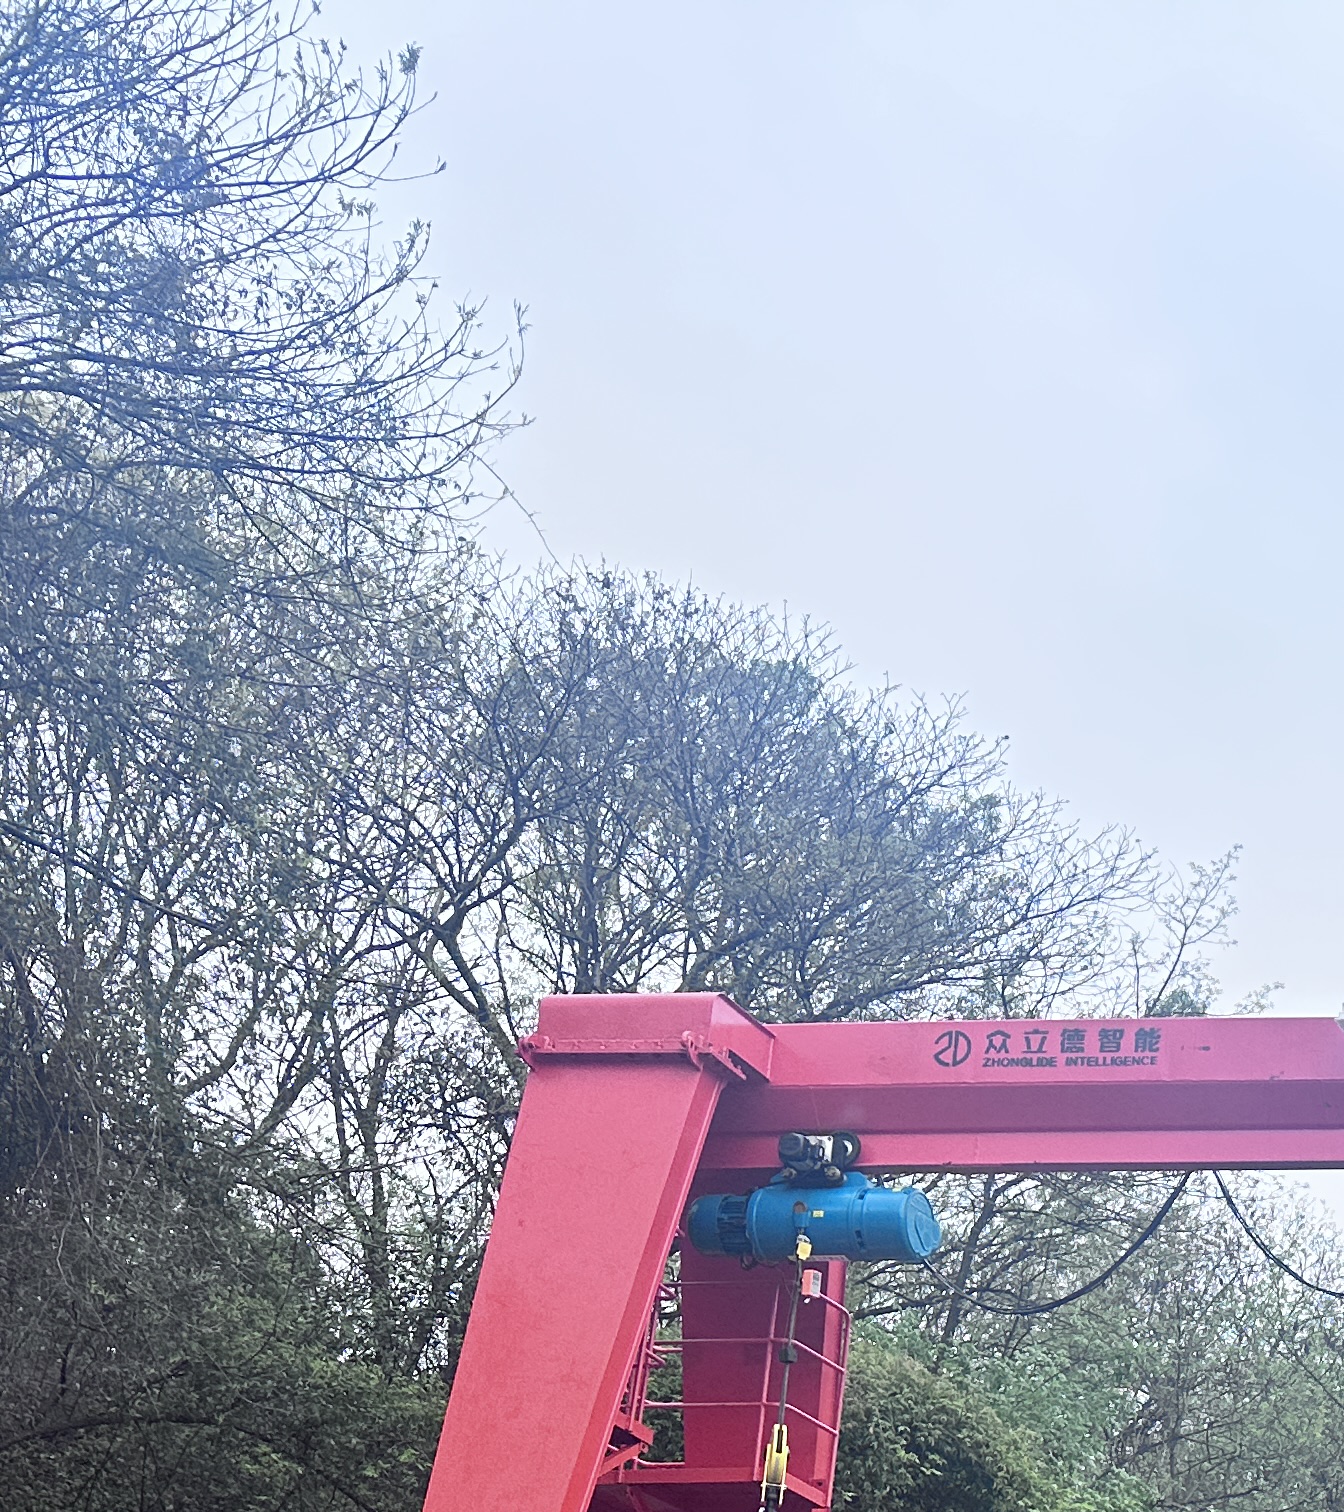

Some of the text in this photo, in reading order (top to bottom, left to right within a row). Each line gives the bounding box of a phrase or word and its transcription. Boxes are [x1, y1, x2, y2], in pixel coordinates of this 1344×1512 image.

[984, 1028, 1162, 1055] 众立德智能
[982, 1056, 1159, 1068] ZHONGLIDE INTELLIGENCE
